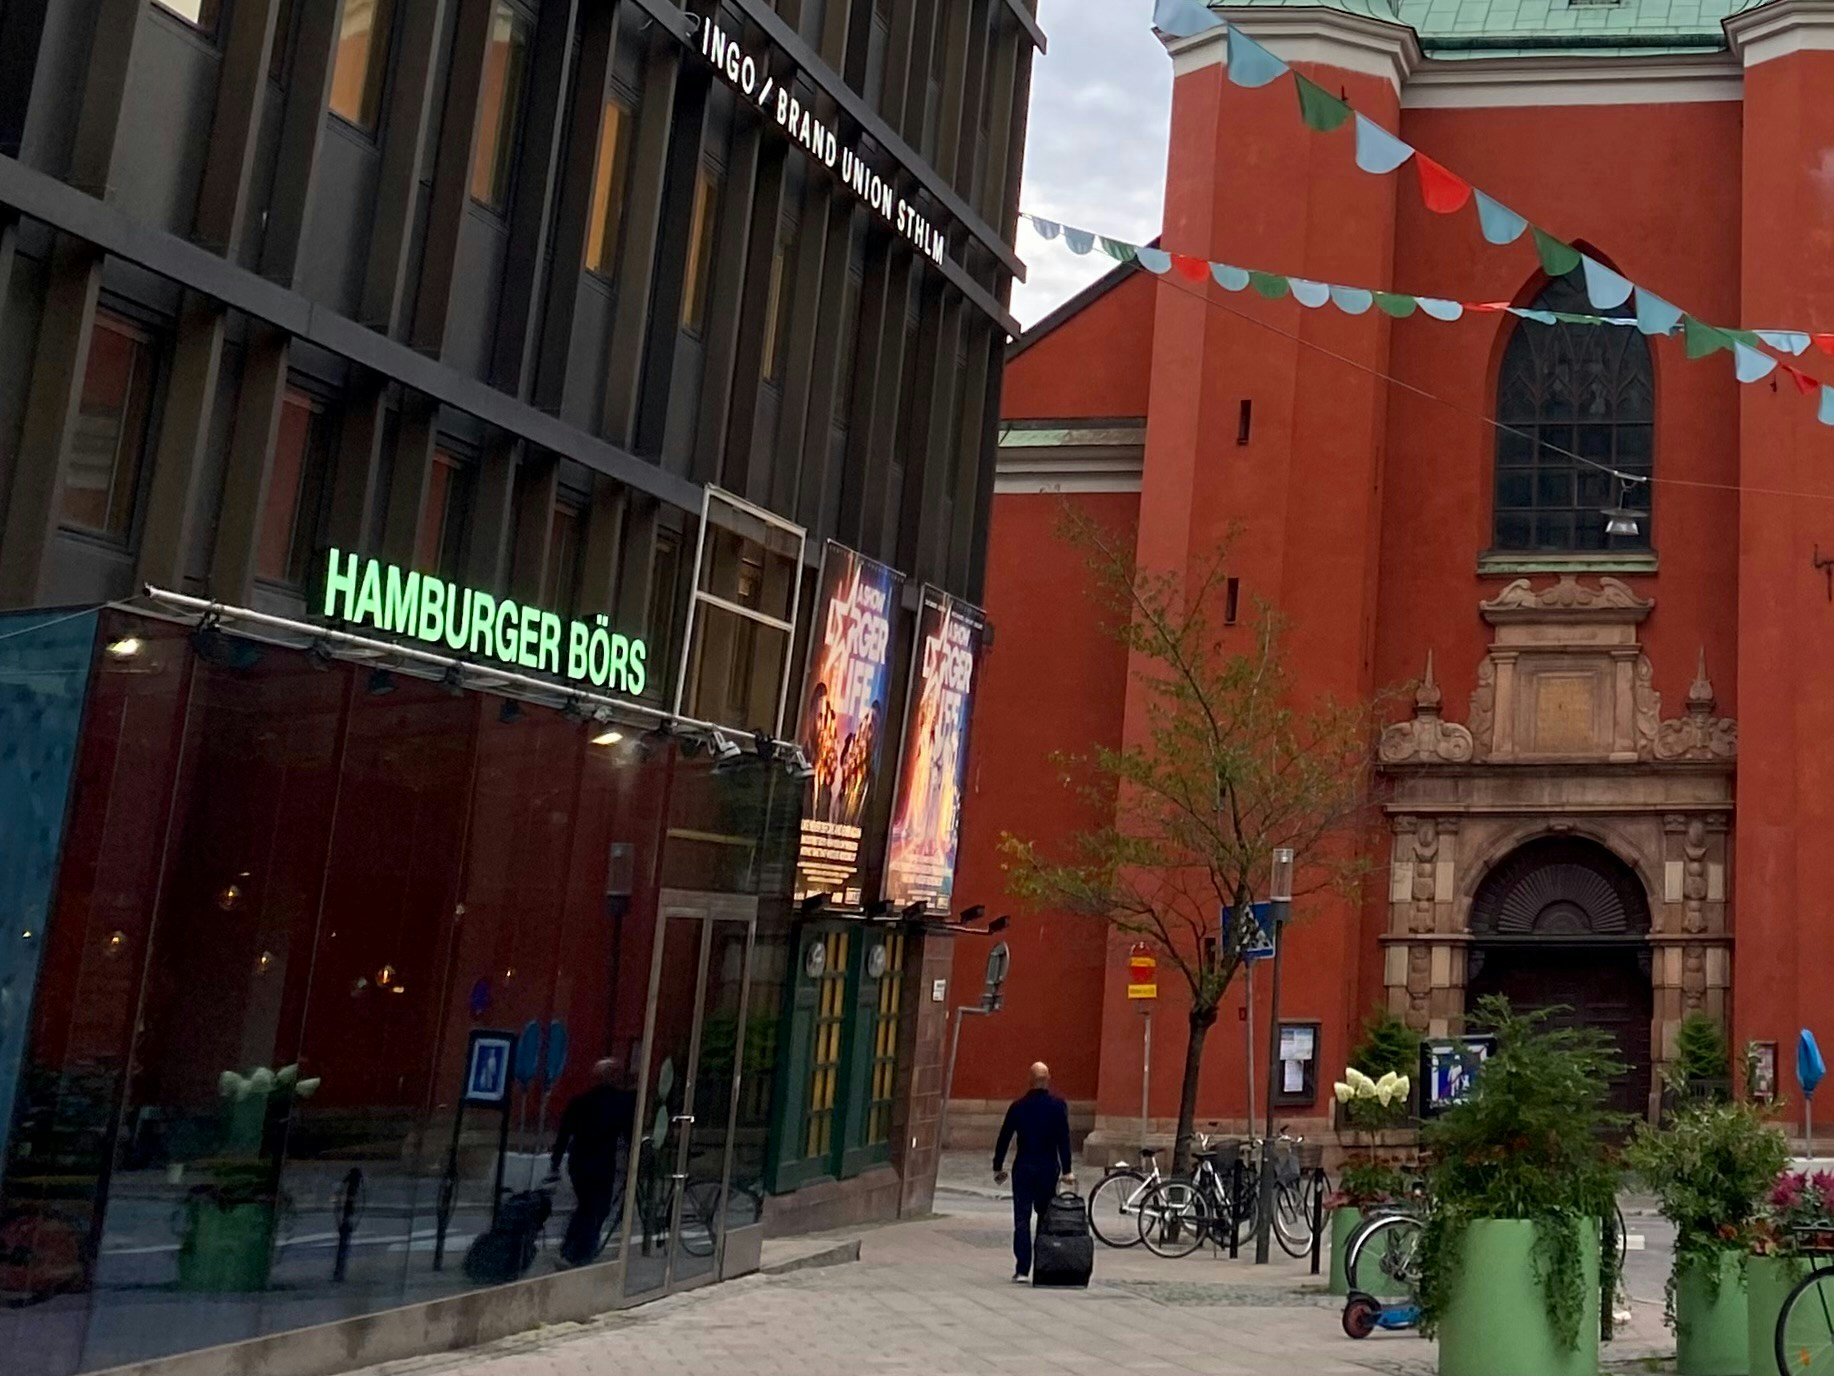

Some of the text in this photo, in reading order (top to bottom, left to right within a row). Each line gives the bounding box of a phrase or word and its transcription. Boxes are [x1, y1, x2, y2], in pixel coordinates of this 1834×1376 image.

[702, 17, 945, 266] INGO / BRAND UNION STHLM
[324, 547, 647, 696] HAMBURGER BÖRS
